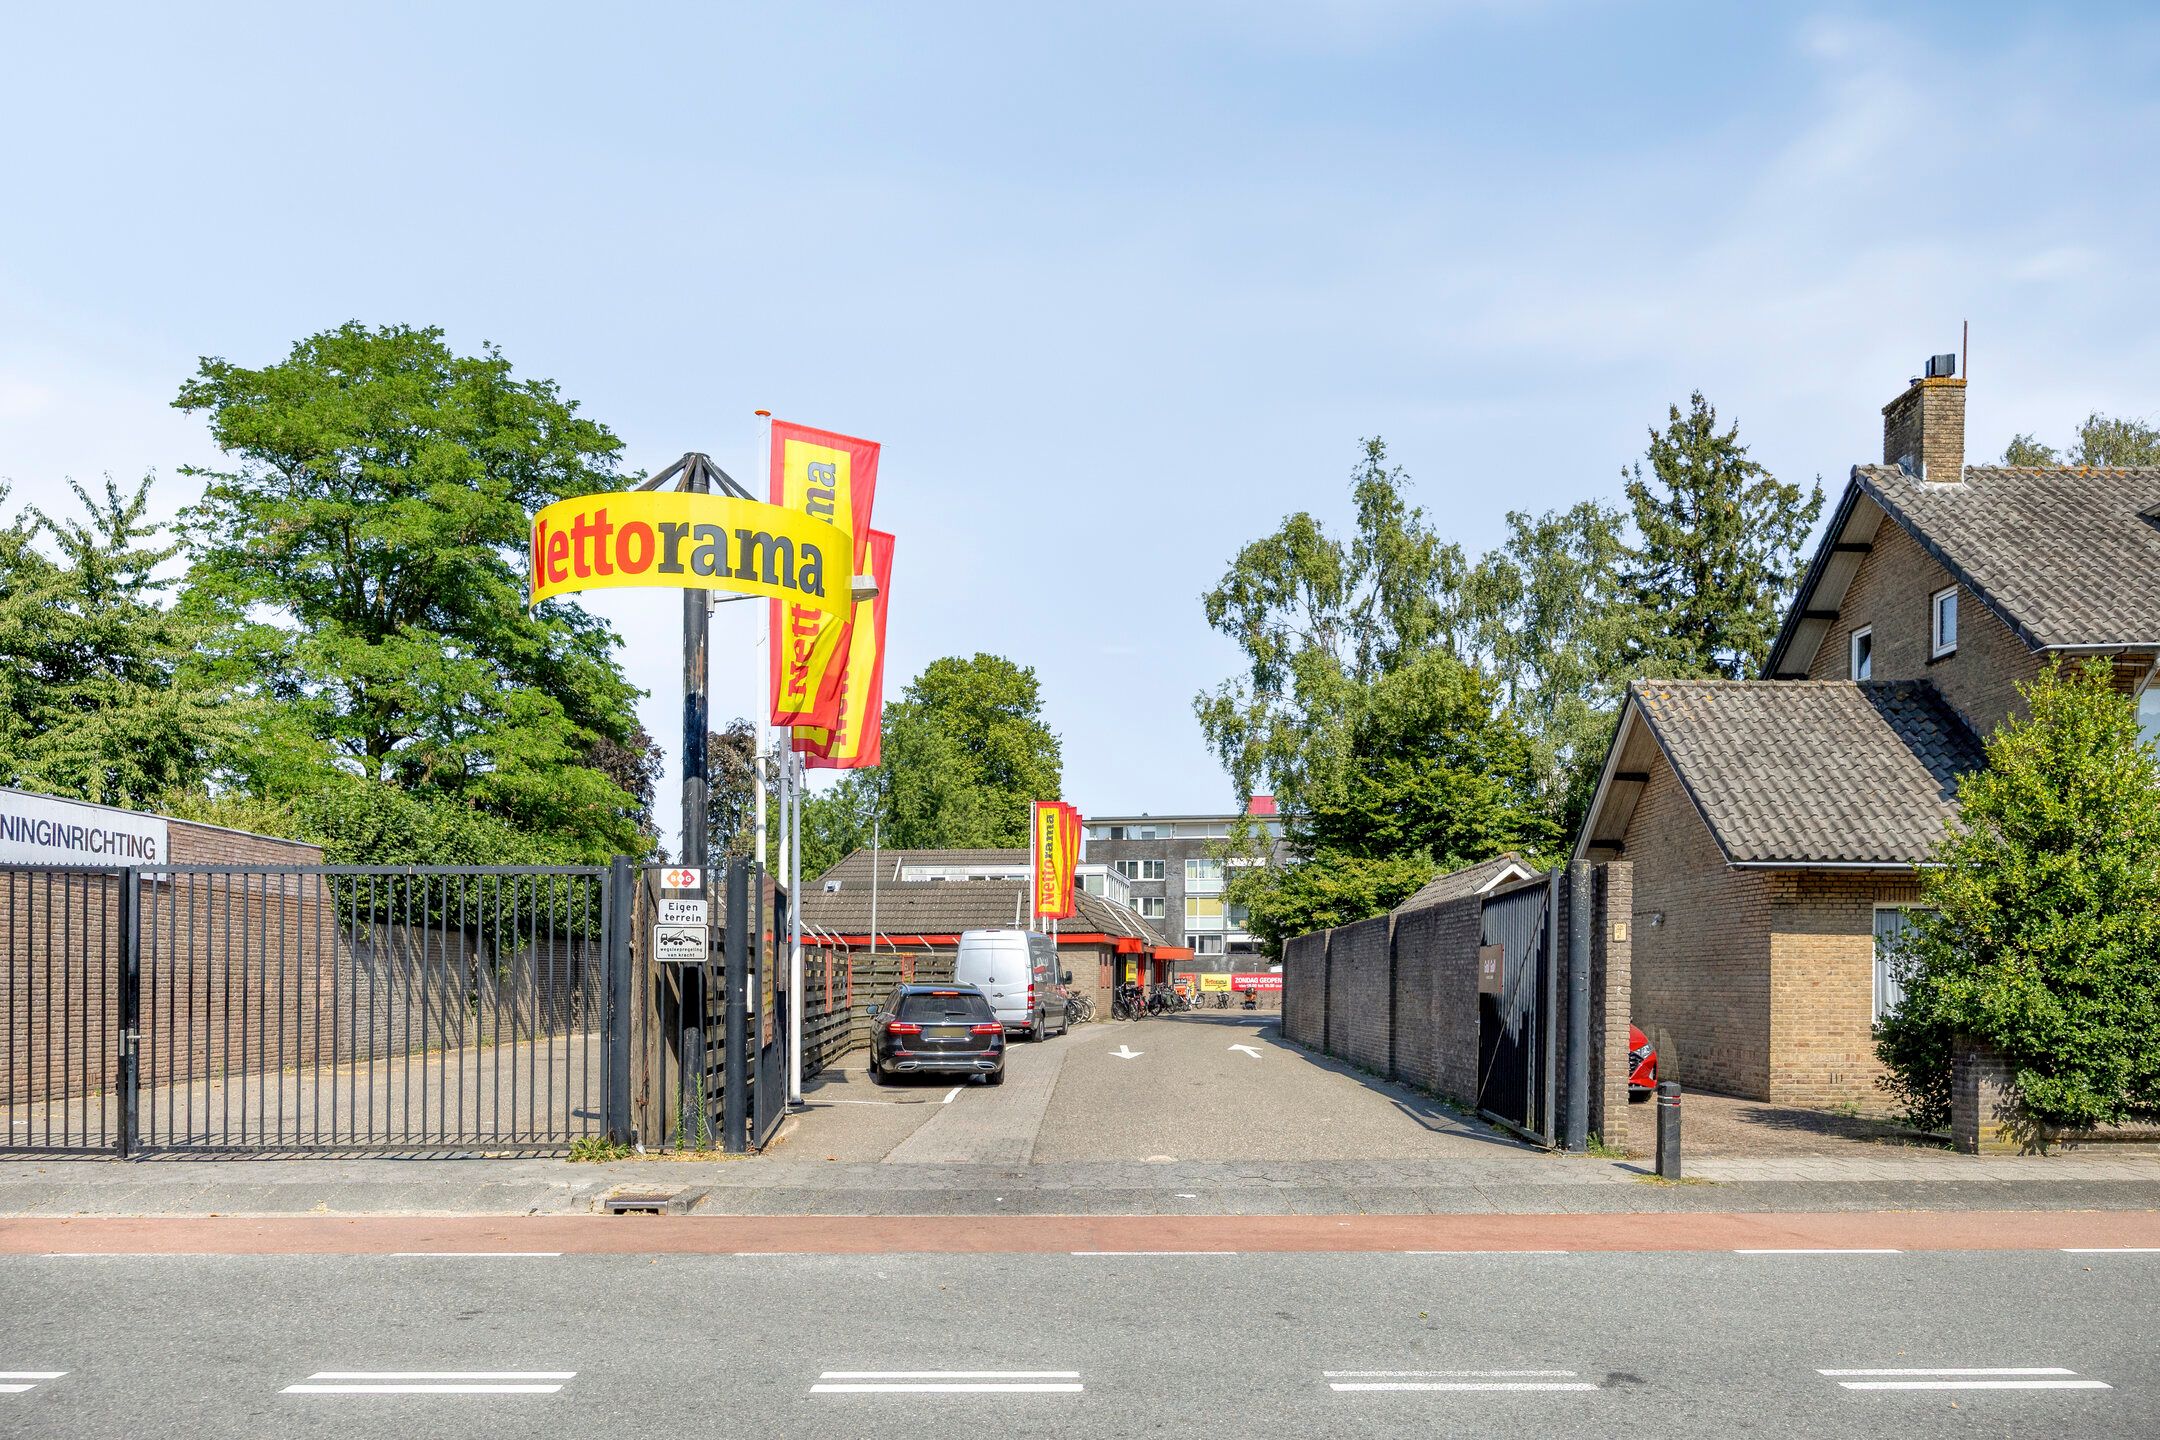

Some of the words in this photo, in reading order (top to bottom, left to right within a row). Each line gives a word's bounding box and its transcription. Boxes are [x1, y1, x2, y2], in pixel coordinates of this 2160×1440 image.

[531, 508, 825, 598] Nettorama
[0, 813, 156, 861] NINGINRICHTING
[1041, 814, 1055, 905] Nettorama
[664, 913, 702, 922] terrein
[668, 902, 698, 913] Eigen
